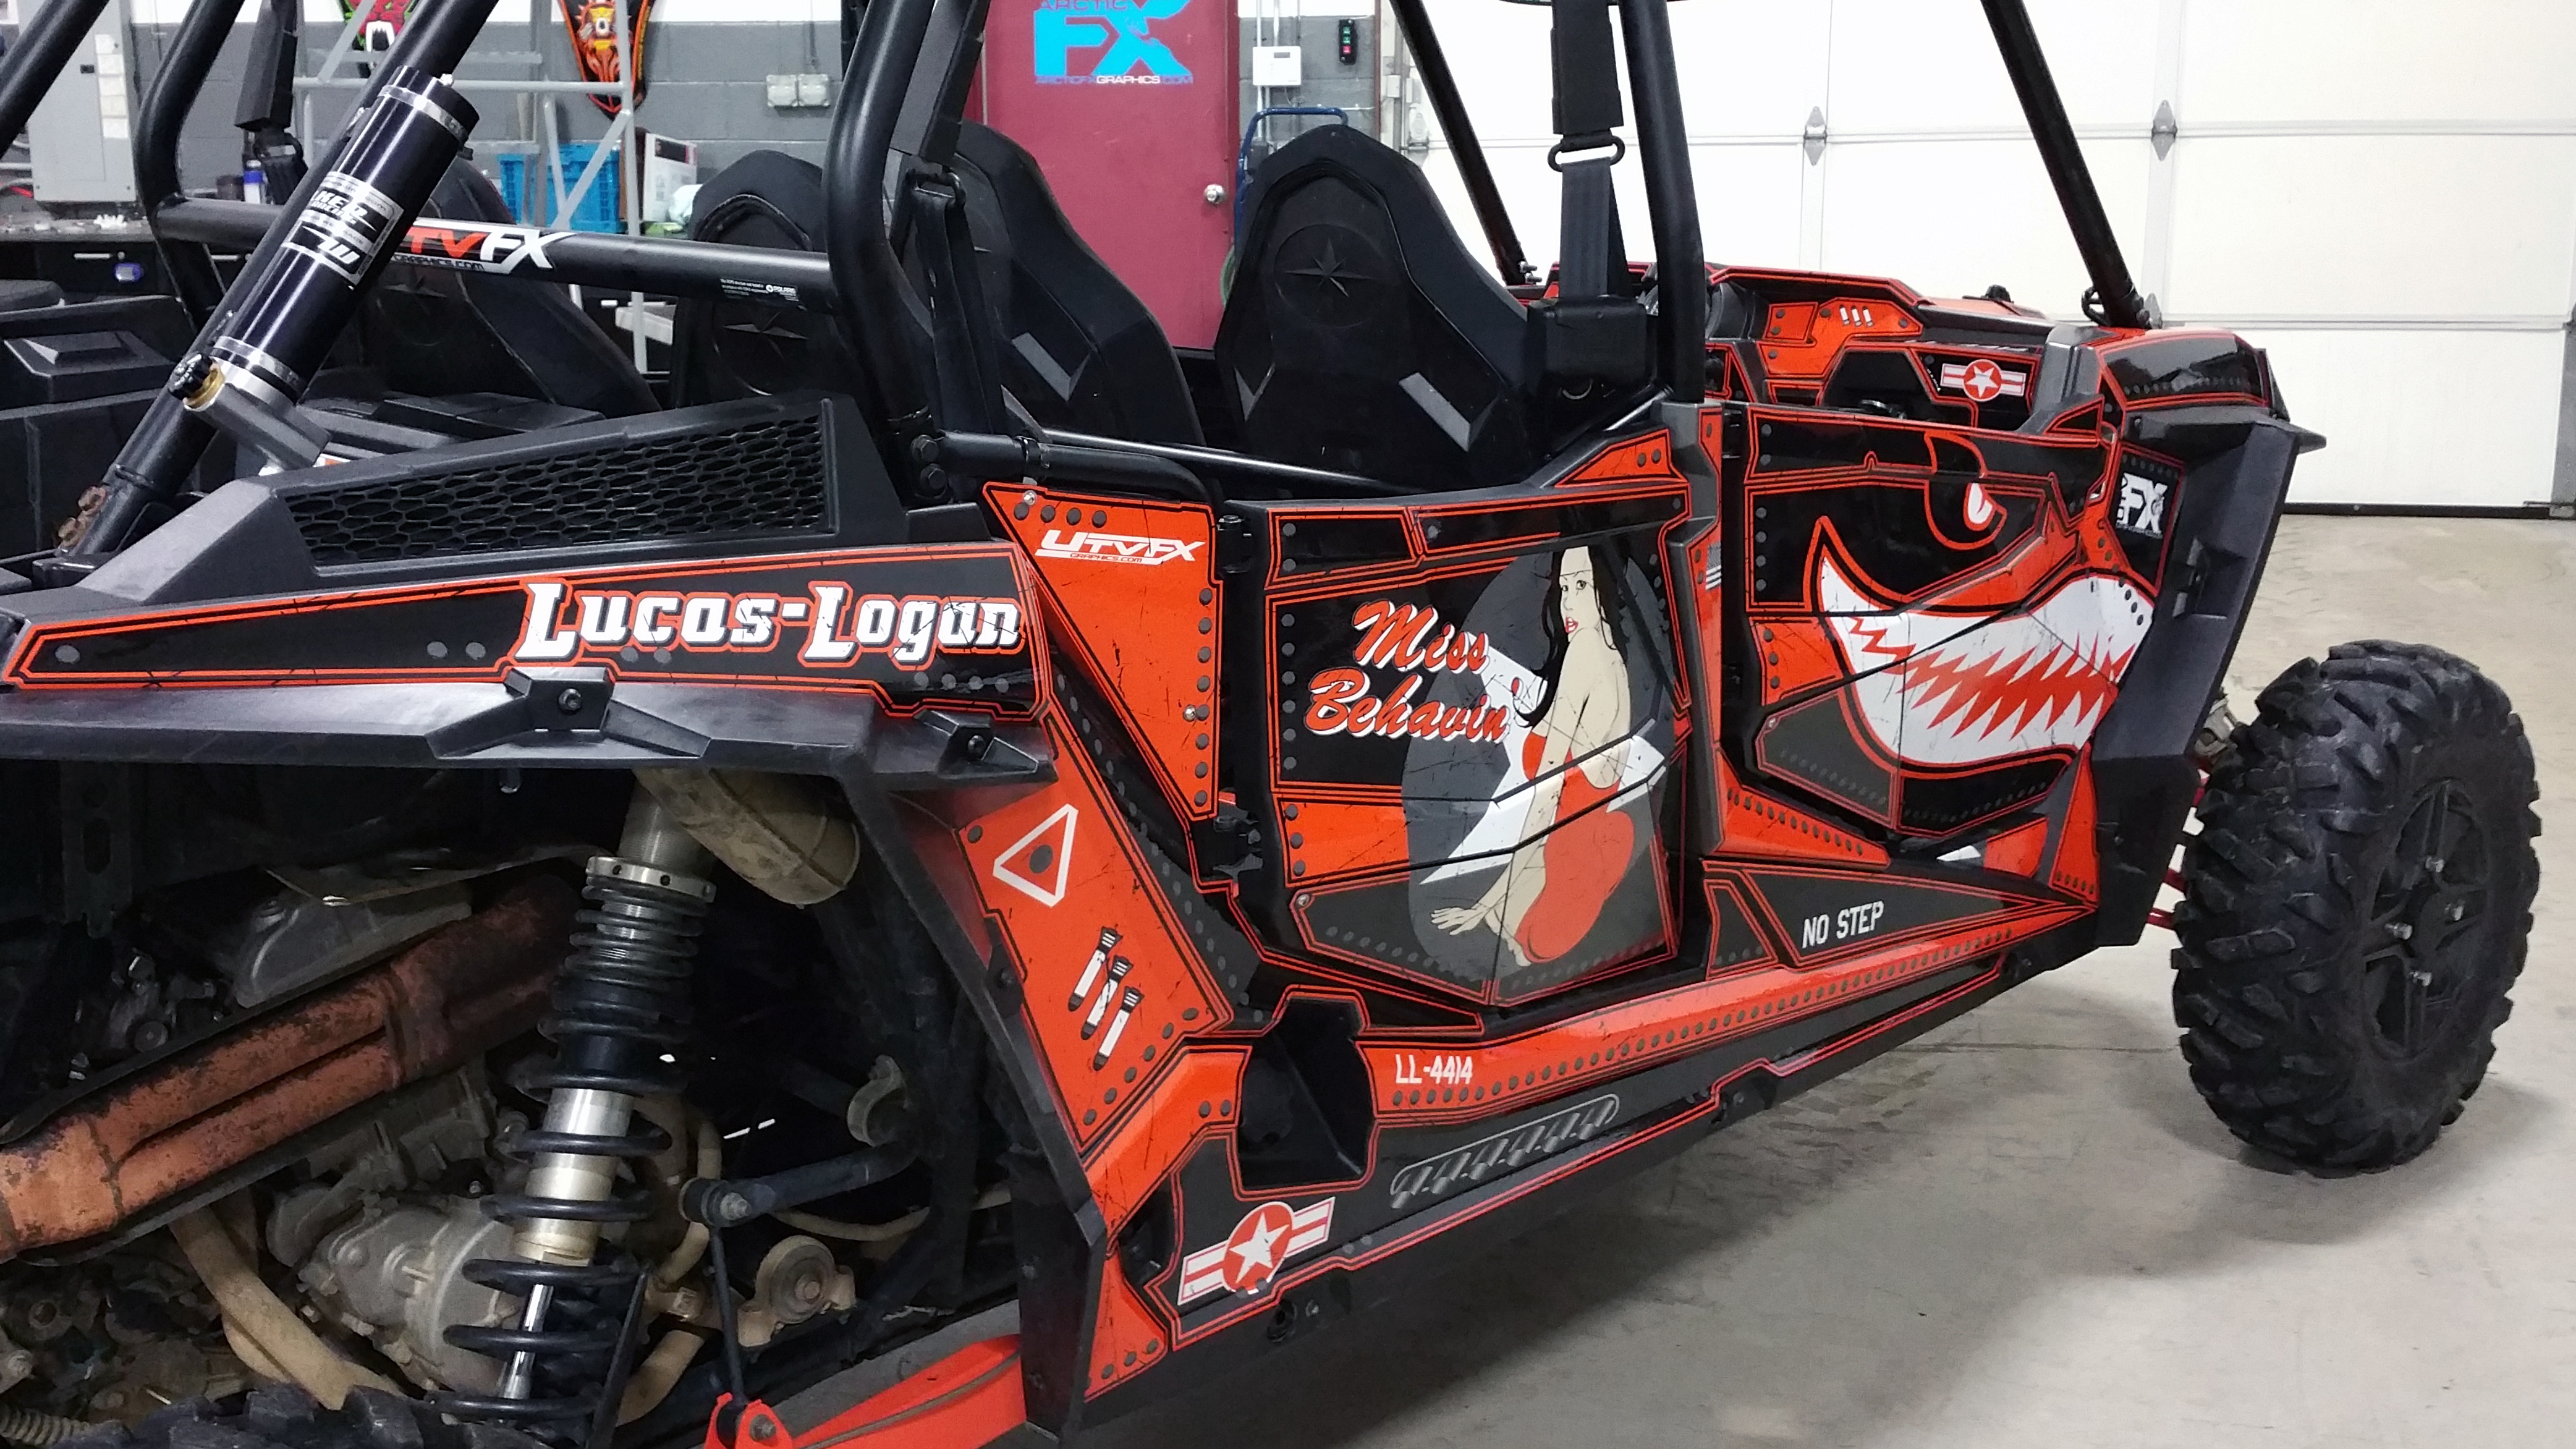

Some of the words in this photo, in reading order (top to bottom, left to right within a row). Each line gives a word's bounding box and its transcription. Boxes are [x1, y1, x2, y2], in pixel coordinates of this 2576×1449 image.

[1039, 0, 1127, 11] ARCTIC
[405, 226, 576, 270] TVFX
[1041, 529, 1205, 562] UTVFX
[1351, 598, 1489, 674] Miss
[1802, 914, 1829, 948] NO
[1836, 901, 1884, 939] STEP
[1396, 1054, 1473, 1084] LL-4414
